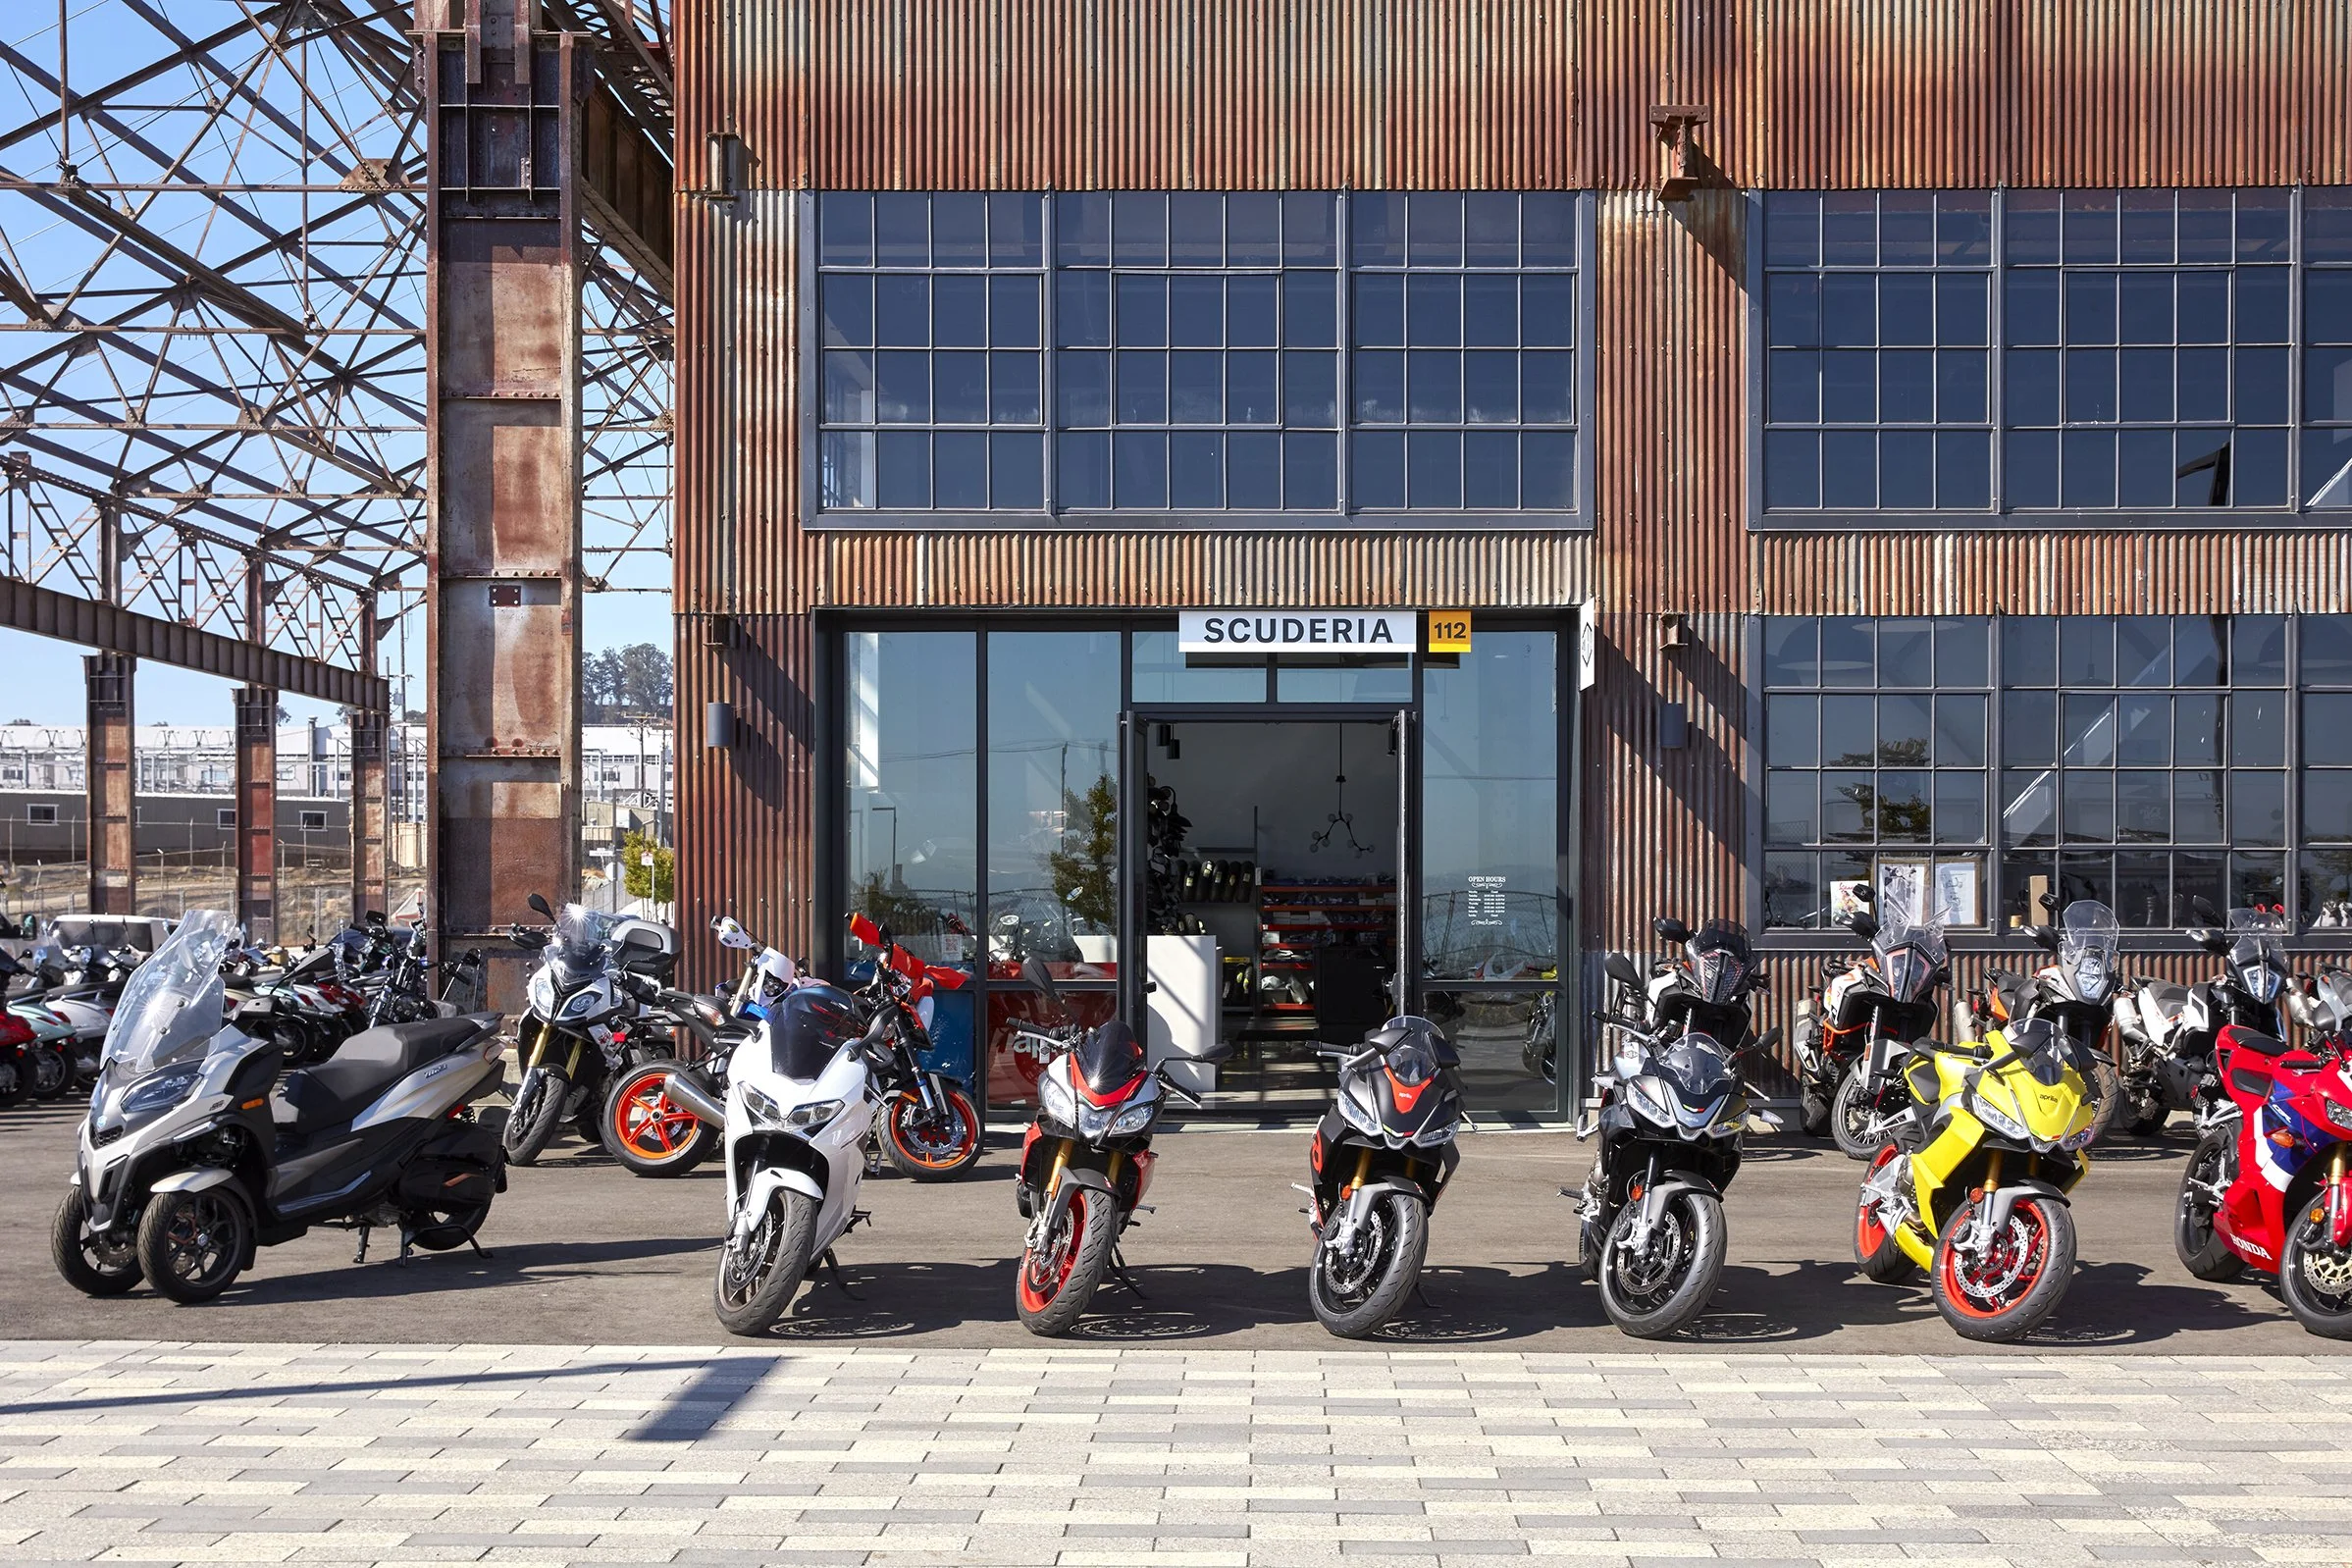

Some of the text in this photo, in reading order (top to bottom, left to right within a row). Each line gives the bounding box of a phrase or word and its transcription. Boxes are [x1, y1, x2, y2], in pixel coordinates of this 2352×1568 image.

[1204, 617, 1393, 644] SCUDERIA
[1434, 621, 1466, 639] 112
[2039, 1093, 2059, 1104] aprilia
[2228, 1232, 2274, 1261] HONDA
